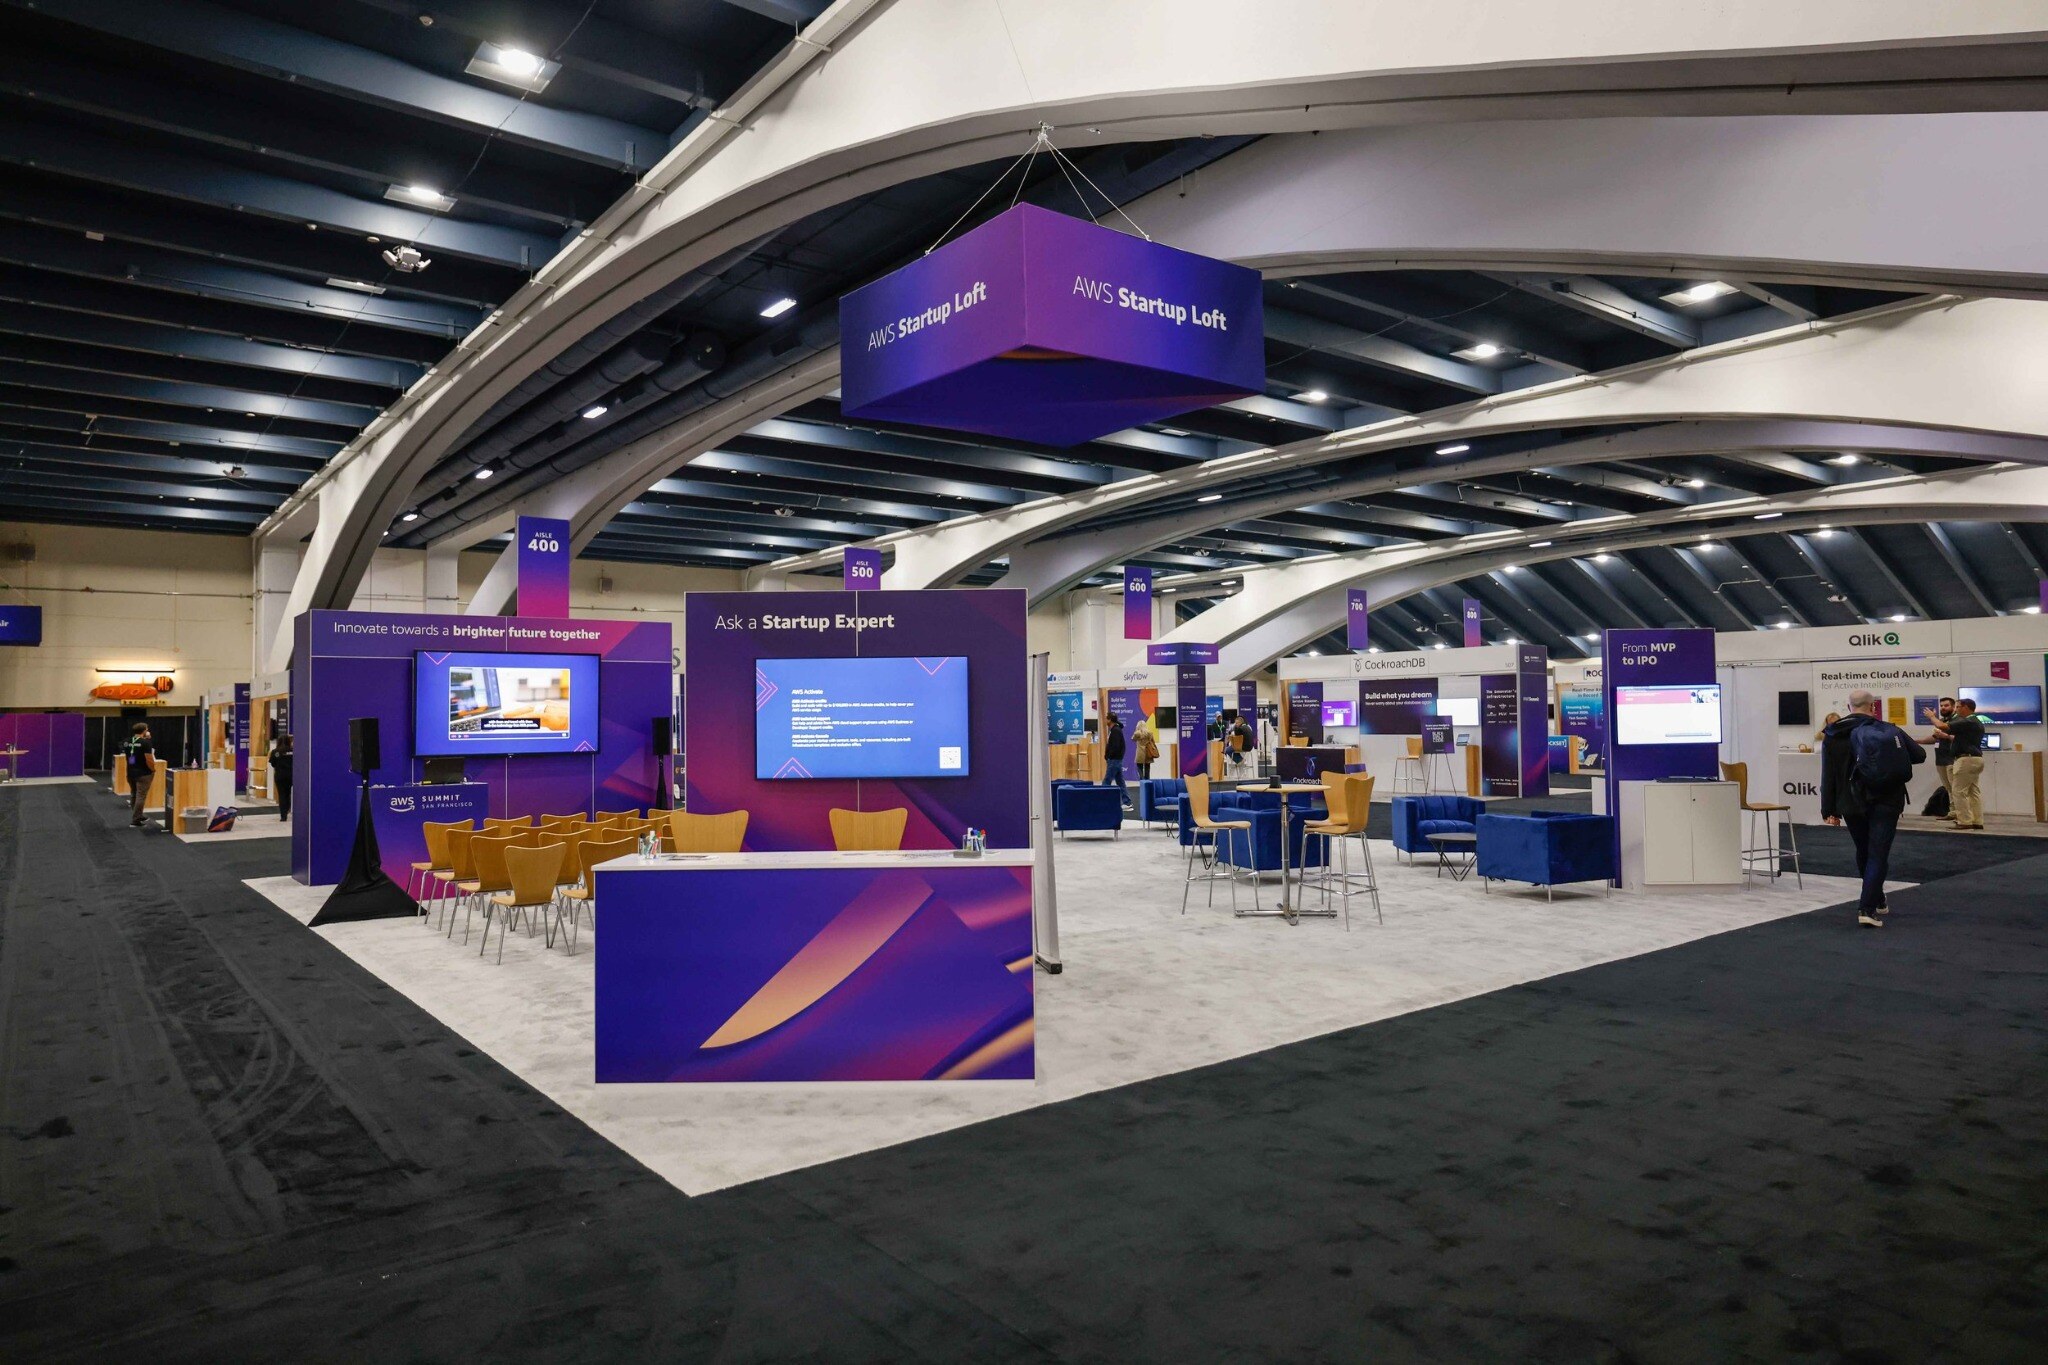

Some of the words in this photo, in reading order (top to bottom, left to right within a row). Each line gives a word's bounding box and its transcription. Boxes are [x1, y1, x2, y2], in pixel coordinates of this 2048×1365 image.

[1072, 276, 1114, 304] AWS
[1118, 286, 1186, 326] Startup
[1192, 305, 1226, 330] Loft
[868, 323, 896, 352] AWS
[898, 302, 950, 338] Startup
[955, 281, 986, 313] Loft
[528, 538, 559, 552] 400
[852, 566, 873, 578] 500
[1130, 582, 1146, 592] 600
[1350, 602, 1363, 610] 700
[714, 614, 743, 630] Ask
[748, 618, 757, 630] a
[762, 614, 830, 632] Startup
[835, 614, 895, 632] Expert
[334, 622, 388, 634] Innovate
[392, 624, 439, 636] towards
[442, 628, 449, 636] a
[453, 625, 506, 639] brighter
[508, 626, 546, 638] future
[550, 628, 601, 641] together
[1848, 634, 1882, 647] Qlik
[1622, 643, 1648, 653] From
[1650, 643, 1676, 652] MVP
[1365, 658, 1426, 670] CockroachDB
[1622, 656, 1634, 665] to
[1637, 656, 1658, 665] IPO
[1124, 671, 1149, 682] skyflow
[1821, 672, 1868, 680] Real-time
[1870, 670, 1899, 679] Cloud
[1902, 669, 1951, 680] Analytics
[1821, 682, 1832, 690] for
[1834, 681, 1859, 690] Active
[1860, 680, 1912, 691] Intelligence.
[1783, 782, 1818, 796] Qlik
[390, 796, 414, 806] aws
